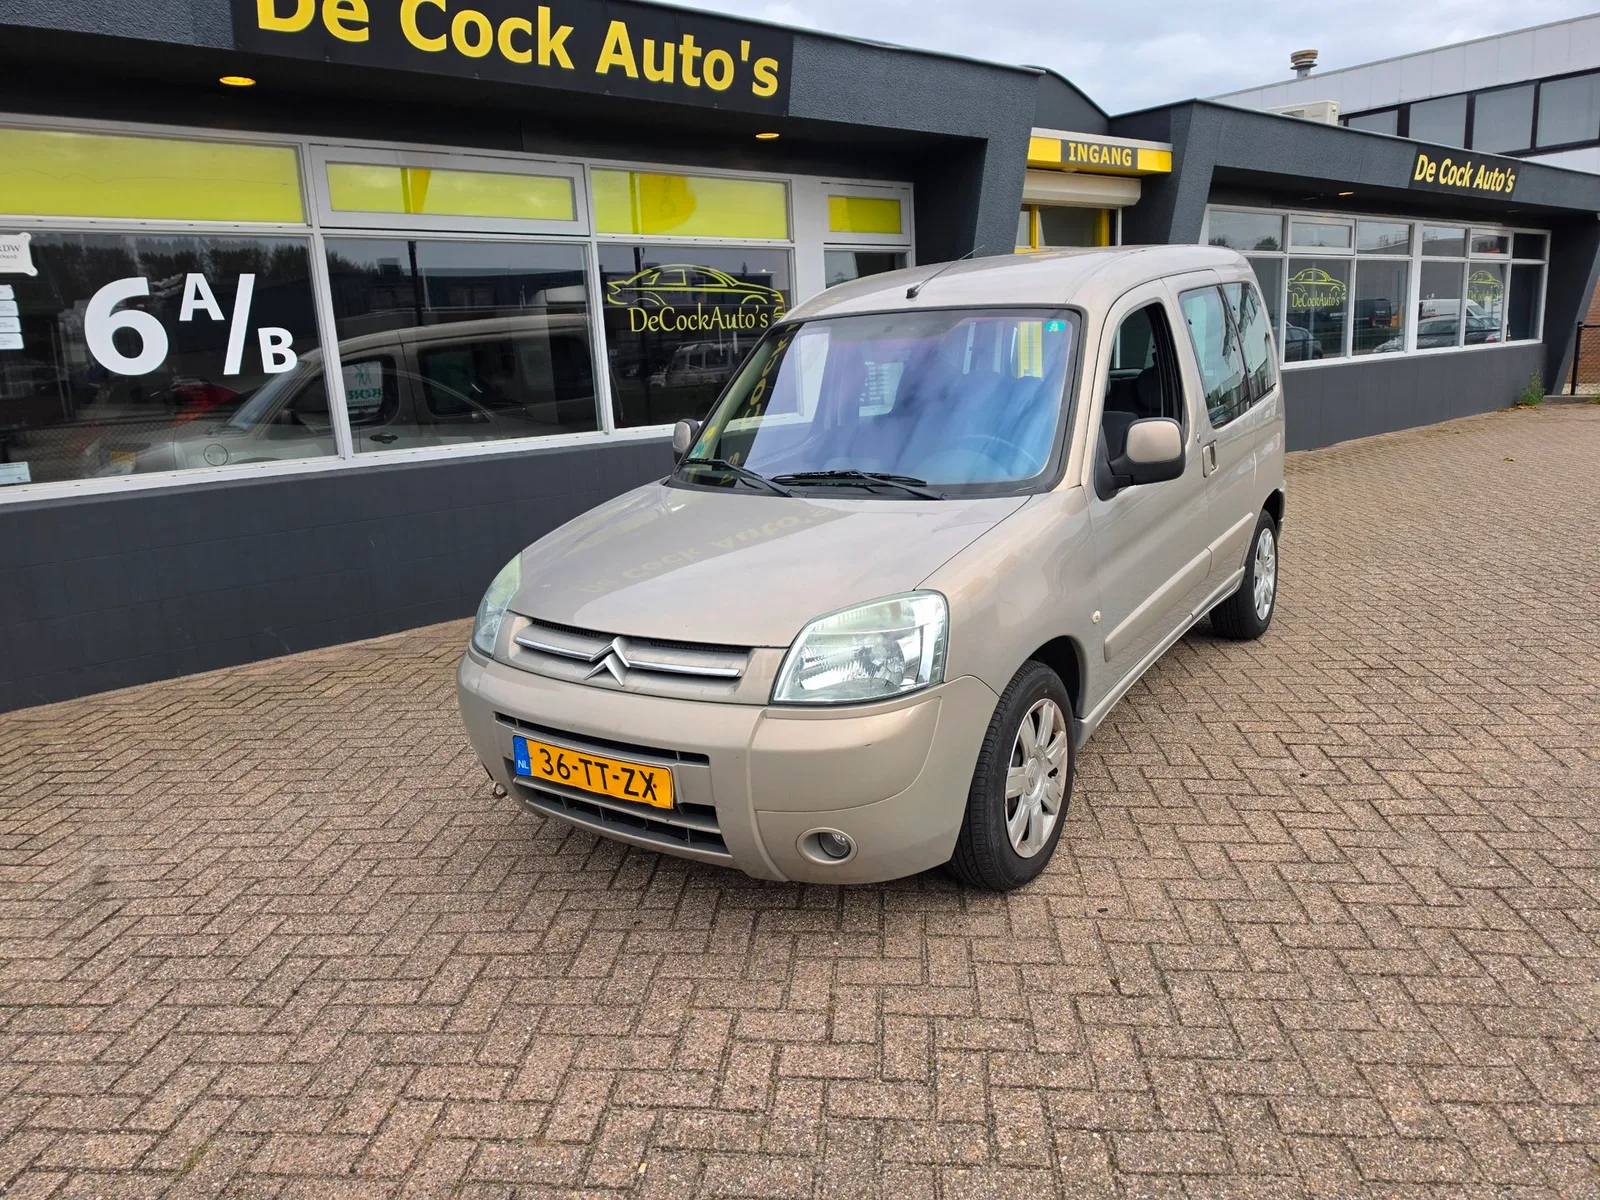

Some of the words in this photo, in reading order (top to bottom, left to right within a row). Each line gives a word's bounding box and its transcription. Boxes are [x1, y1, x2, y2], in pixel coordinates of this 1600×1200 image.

[257, 0, 370, 42] De
[400, 0, 575, 70] Cock
[595, 20, 779, 96] Auto's
[1069, 143, 1132, 167] INGANG
[1414, 154, 1437, 182] De
[1438, 158, 1474, 187] Cock
[1472, 164, 1516, 193] Auto's
[1292, 291, 1340, 308] DeCockAuto's
[84, 276, 169, 376] 6
[627, 302, 769, 333] DeCockAuto's
[517, 759, 530, 770] NL
[539, 748, 657, 801] 36-TT-ZX
